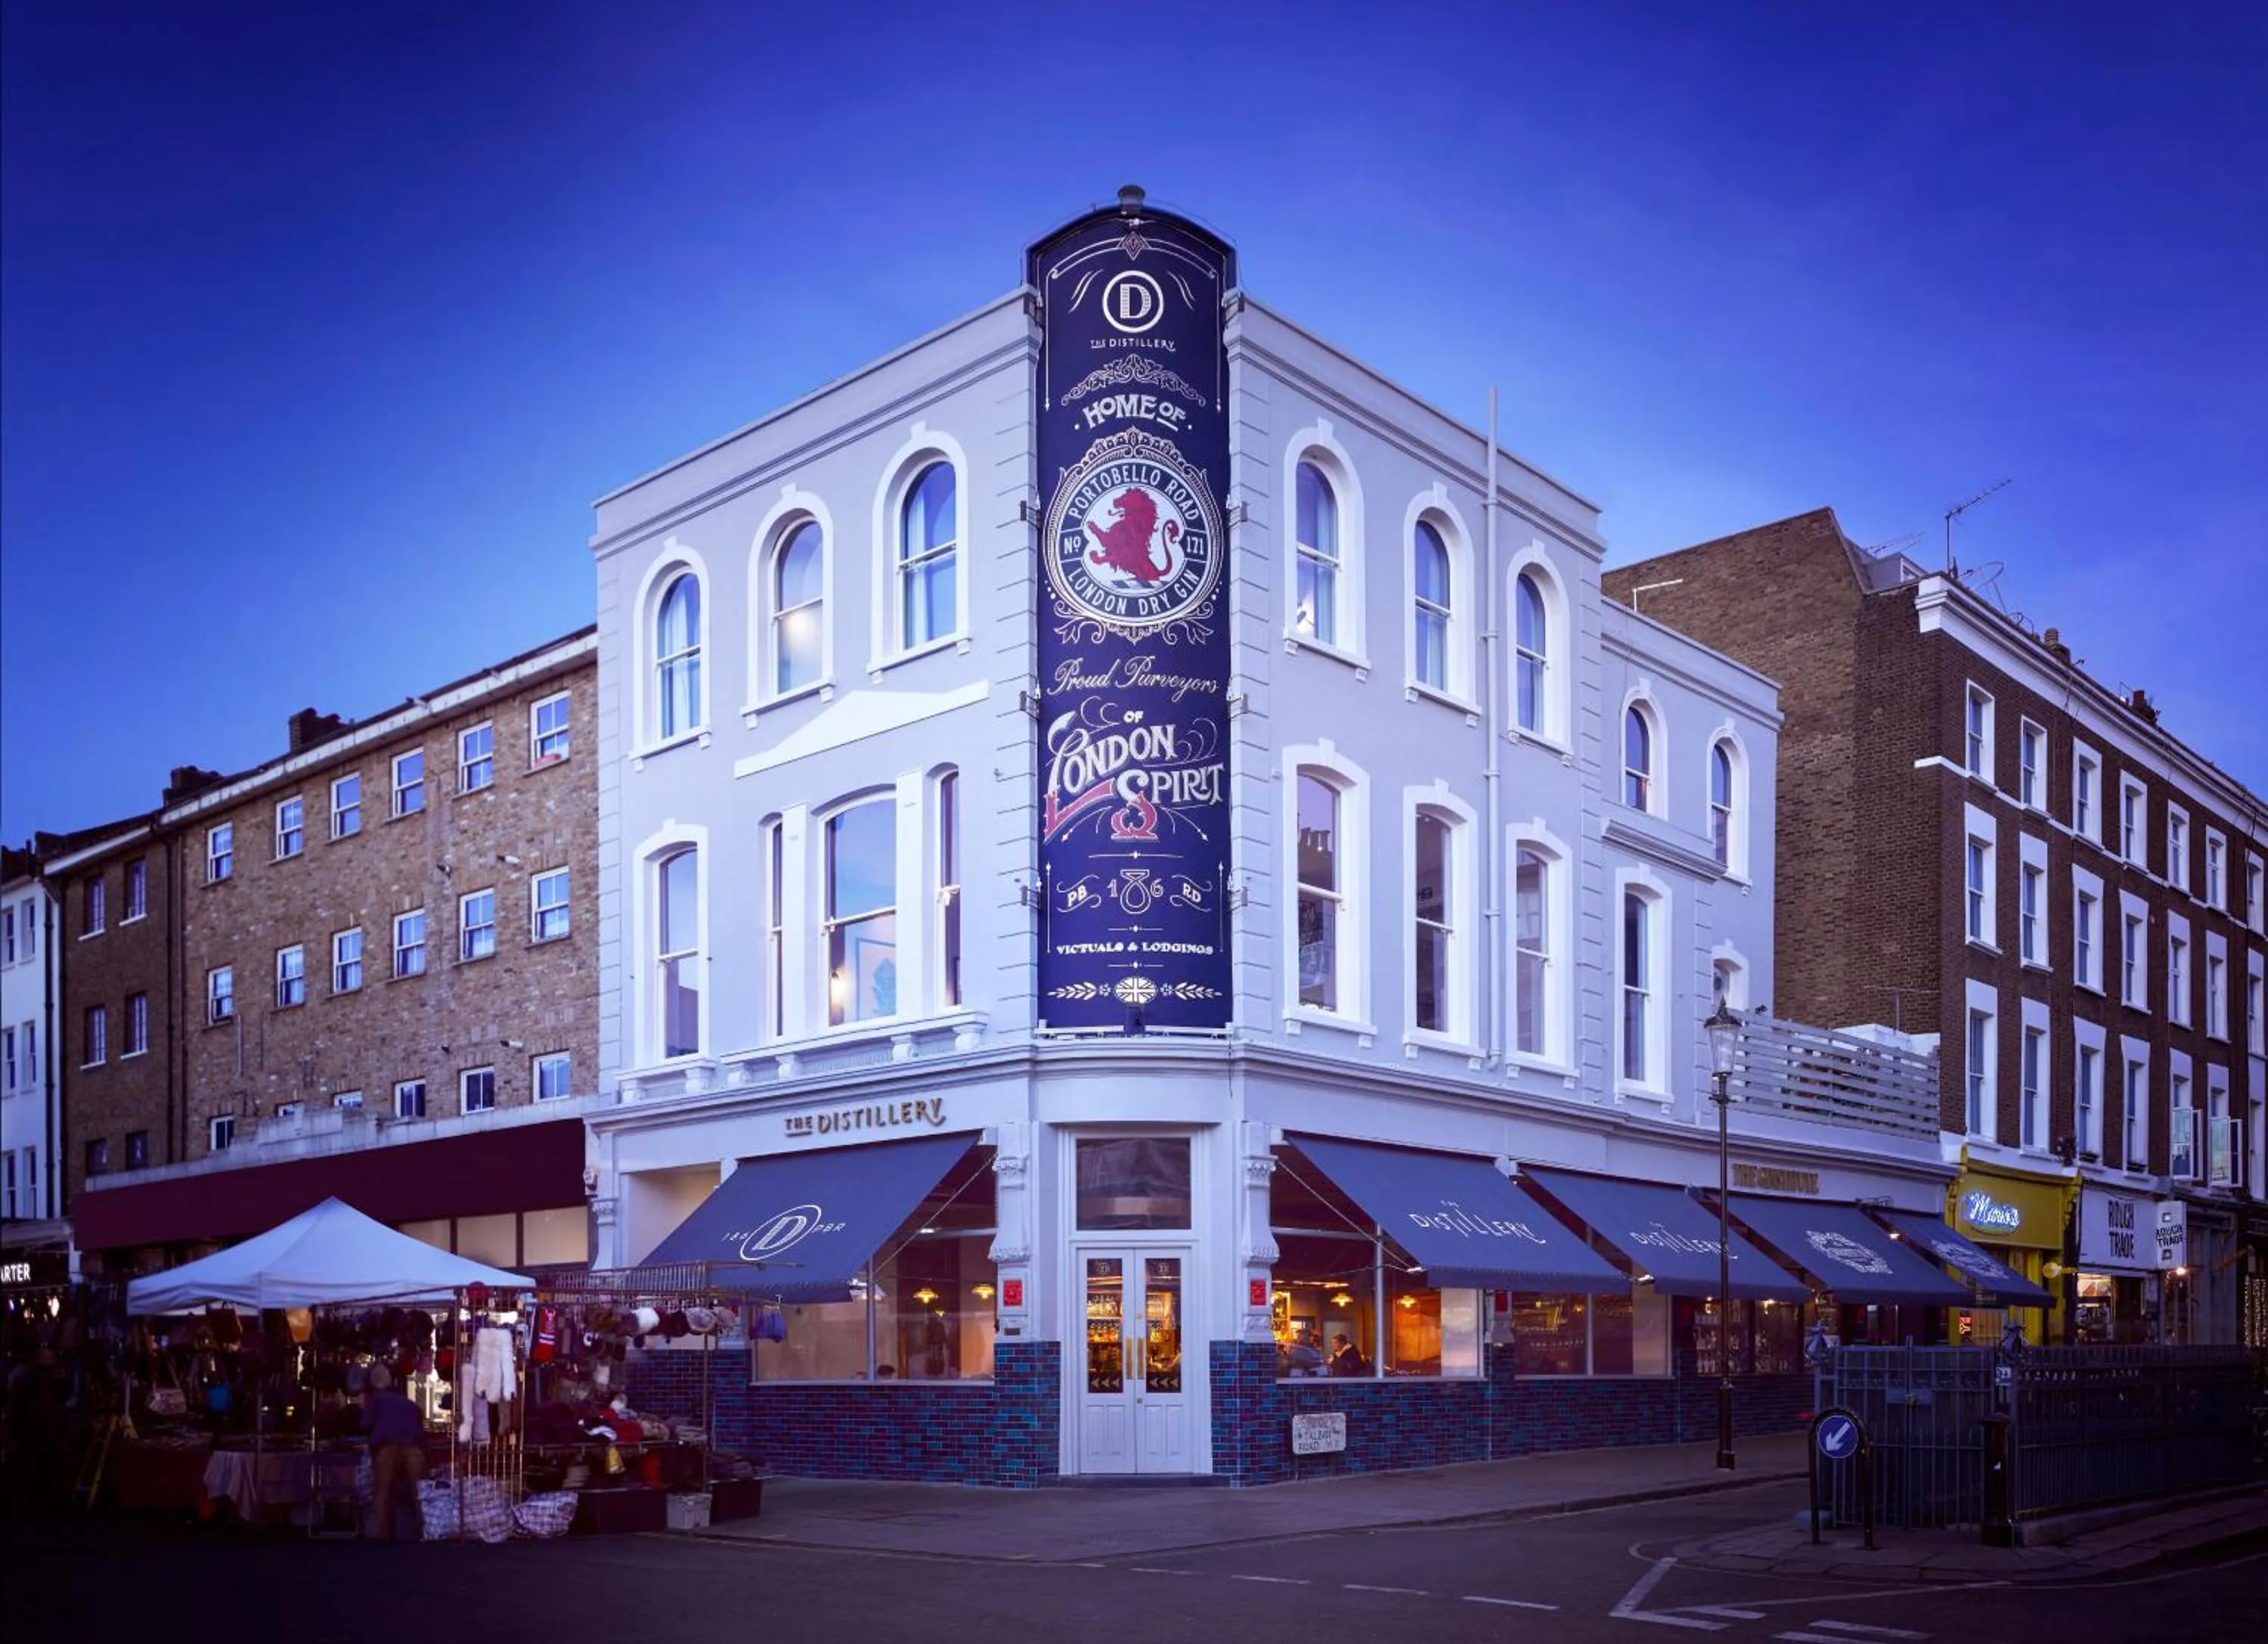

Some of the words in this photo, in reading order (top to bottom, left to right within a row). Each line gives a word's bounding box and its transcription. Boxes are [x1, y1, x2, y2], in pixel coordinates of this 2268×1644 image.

[1120, 284, 1152, 320] D
[1109, 339, 1176, 351] DISTILLERY
[1082, 394, 1157, 428] HOME
[1158, 404, 1186, 423] OF
[1069, 465, 1161, 520] PORTOBELLO
[1165, 479, 1199, 520] ROAD
[1186, 536, 1204, 556] 171
[1068, 569, 1127, 615] LONDON
[1138, 595, 1172, 616] DRY
[1175, 569, 1201, 598] GIN
[1046, 657, 1121, 695] Proud
[1115, 656, 1219, 703] Purveyors
[1123, 710, 1144, 723] OF
[1044, 711, 1179, 844] LONDON
[1111, 762, 1225, 841] SPIRIT
[1067, 885, 1088, 907] PB
[1182, 883, 1202, 904] RD
[1056, 942, 1124, 955] VICTUALS
[1142, 942, 1213, 955] LODGINGS
[785, 1116, 813, 1133] THE
[818, 1097, 947, 1134] DISTILLERY
[751, 1215, 807, 1251] D
[1409, 1210, 1547, 1244] DISTILLERY
[2108, 1231, 2135, 1259] TRADE
